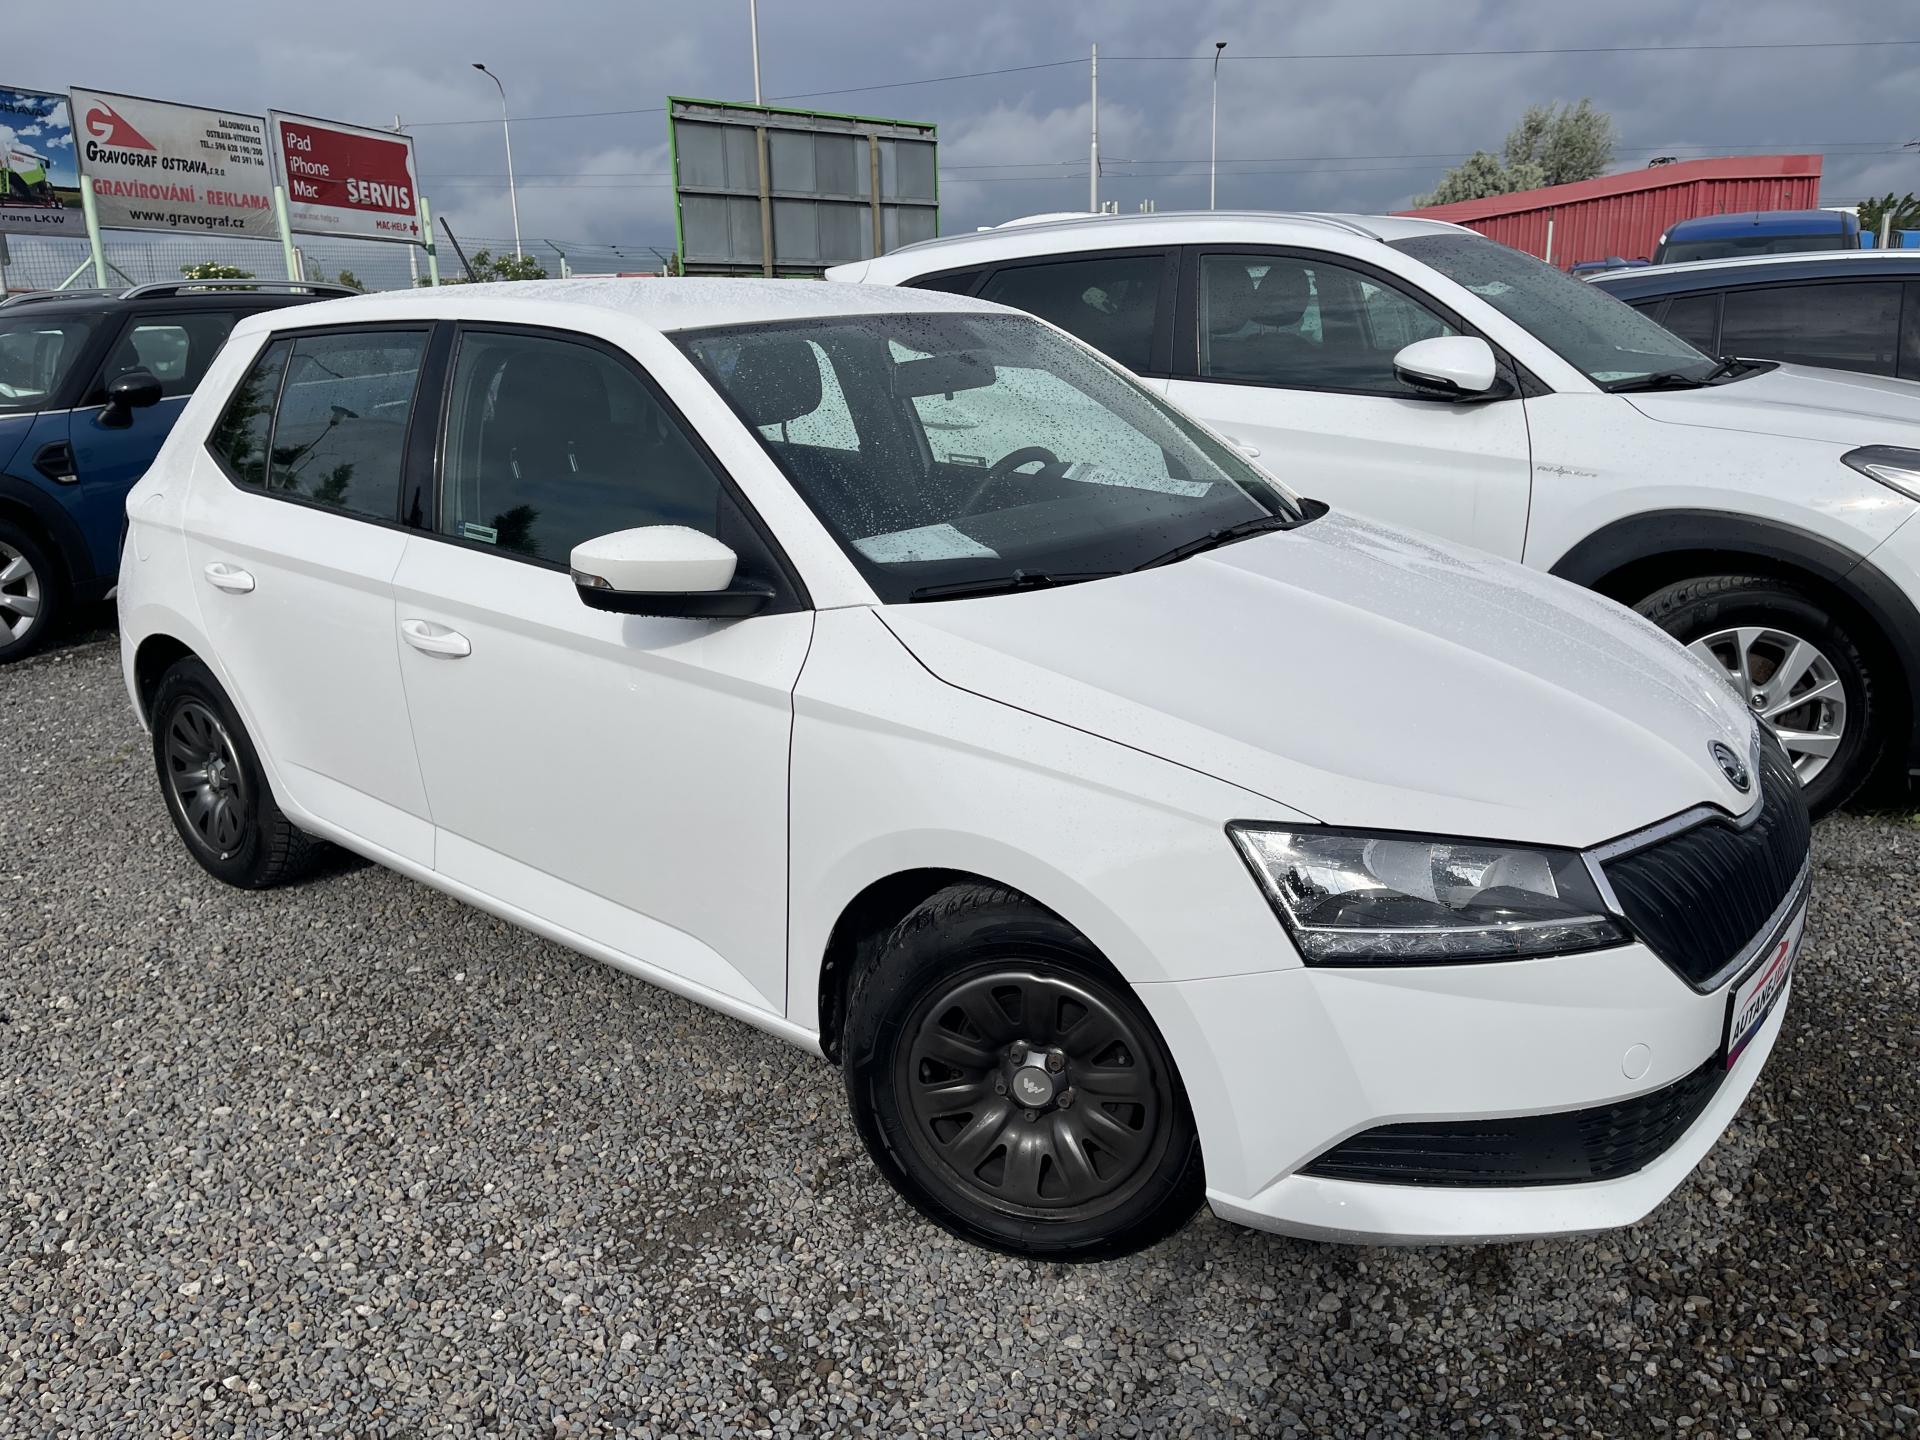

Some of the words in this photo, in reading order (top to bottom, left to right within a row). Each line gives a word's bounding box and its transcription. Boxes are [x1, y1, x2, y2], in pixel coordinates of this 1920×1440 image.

[0, 103, 48, 117] RAVA
[286, 132, 312, 152] iPad
[86, 140, 158, 169] GRAVOGRAF
[289, 156, 330, 177] iPhone
[92, 178, 196, 203] GRAVÍROVÁNÍ
[207, 190, 271, 210] REKLAMA
[293, 179, 319, 199] Mac
[346, 177, 411, 210] SERVIS
[0, 212, 32, 222] rans
[34, 213, 65, 224] LKW
[129, 209, 245, 229] www.gravograf.cz
